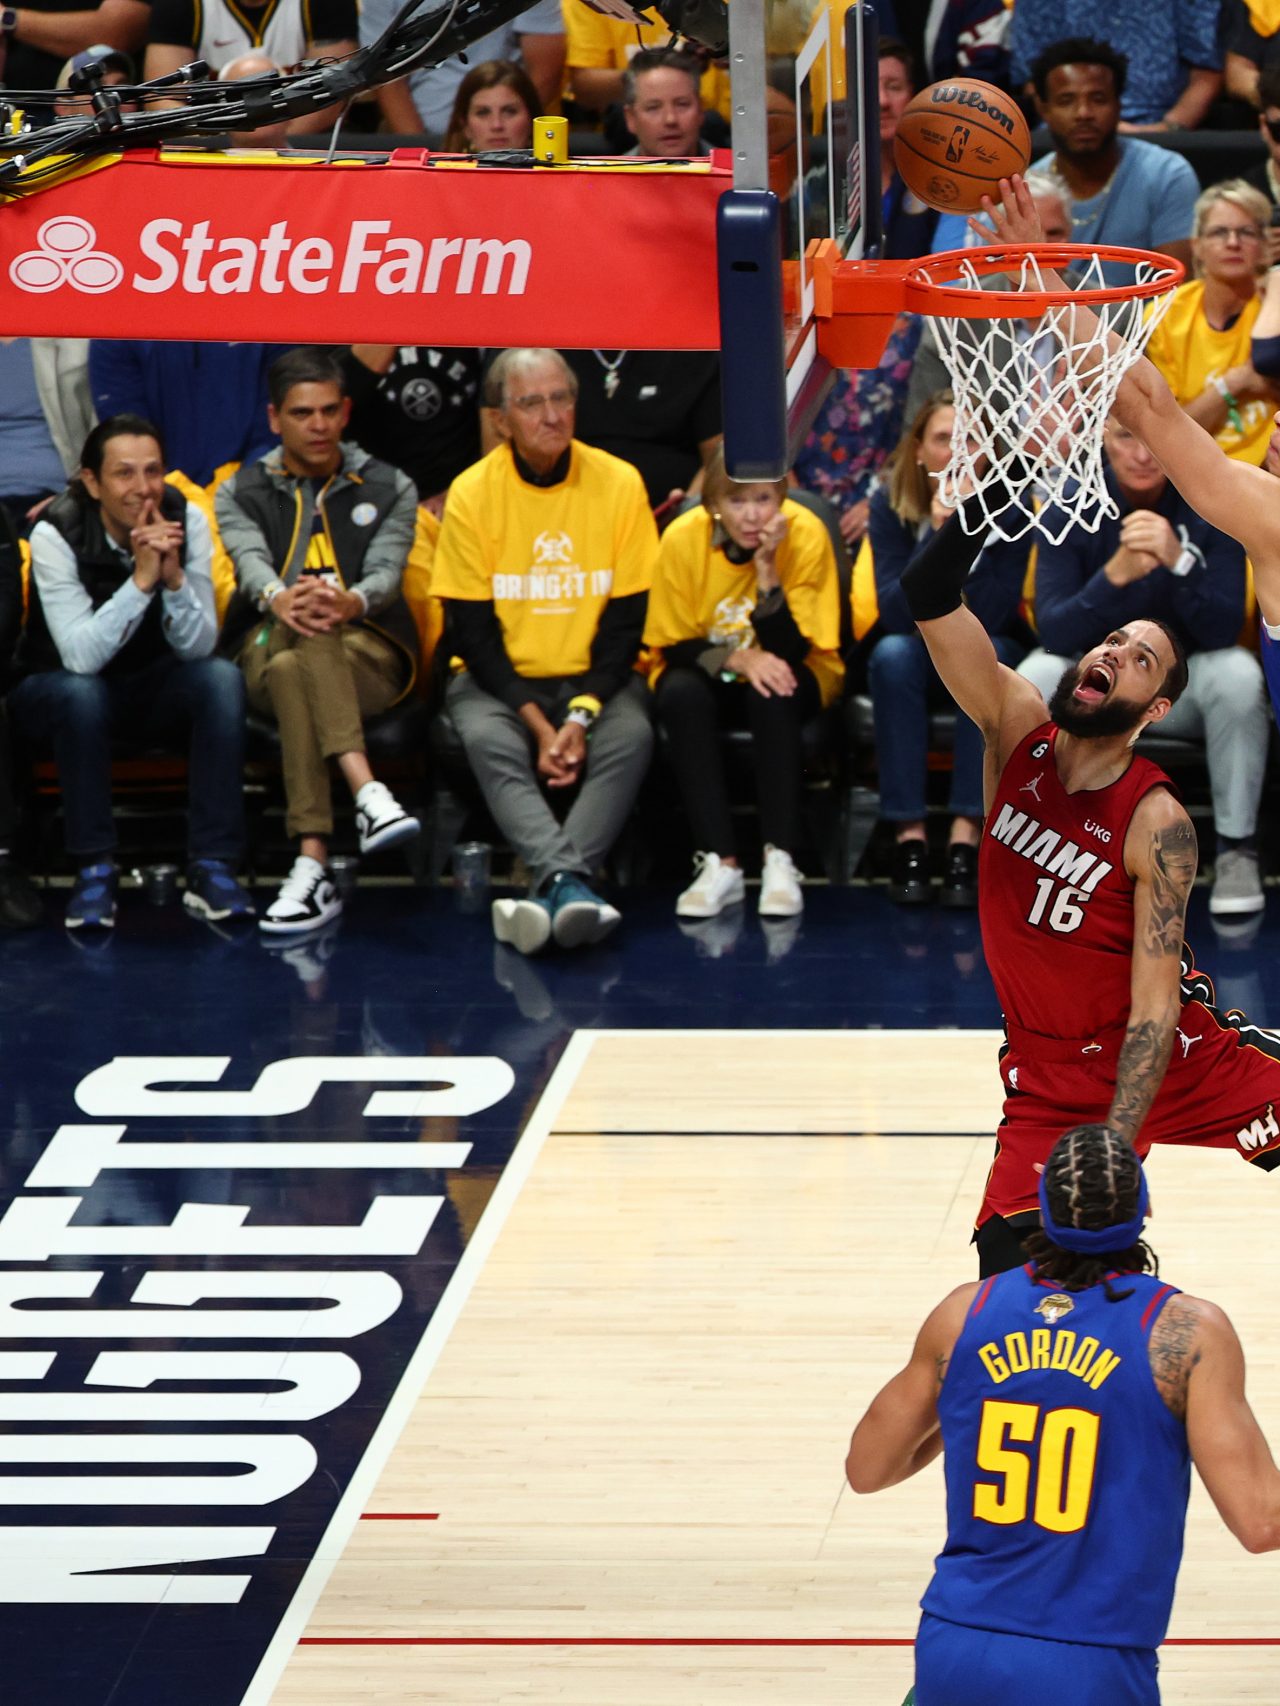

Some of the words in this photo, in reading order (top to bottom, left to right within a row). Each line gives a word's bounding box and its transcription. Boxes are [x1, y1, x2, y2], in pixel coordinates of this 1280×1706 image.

[931, 86, 1014, 135] Wilson
[493, 572, 561, 601] BRING
[1031, 743, 1049, 759] 6
[989, 803, 1114, 894] MIAMI
[1027, 876, 1091, 934] 16
[977, 1328, 1122, 1391] GORDON
[973, 1398, 1101, 1535] 50
